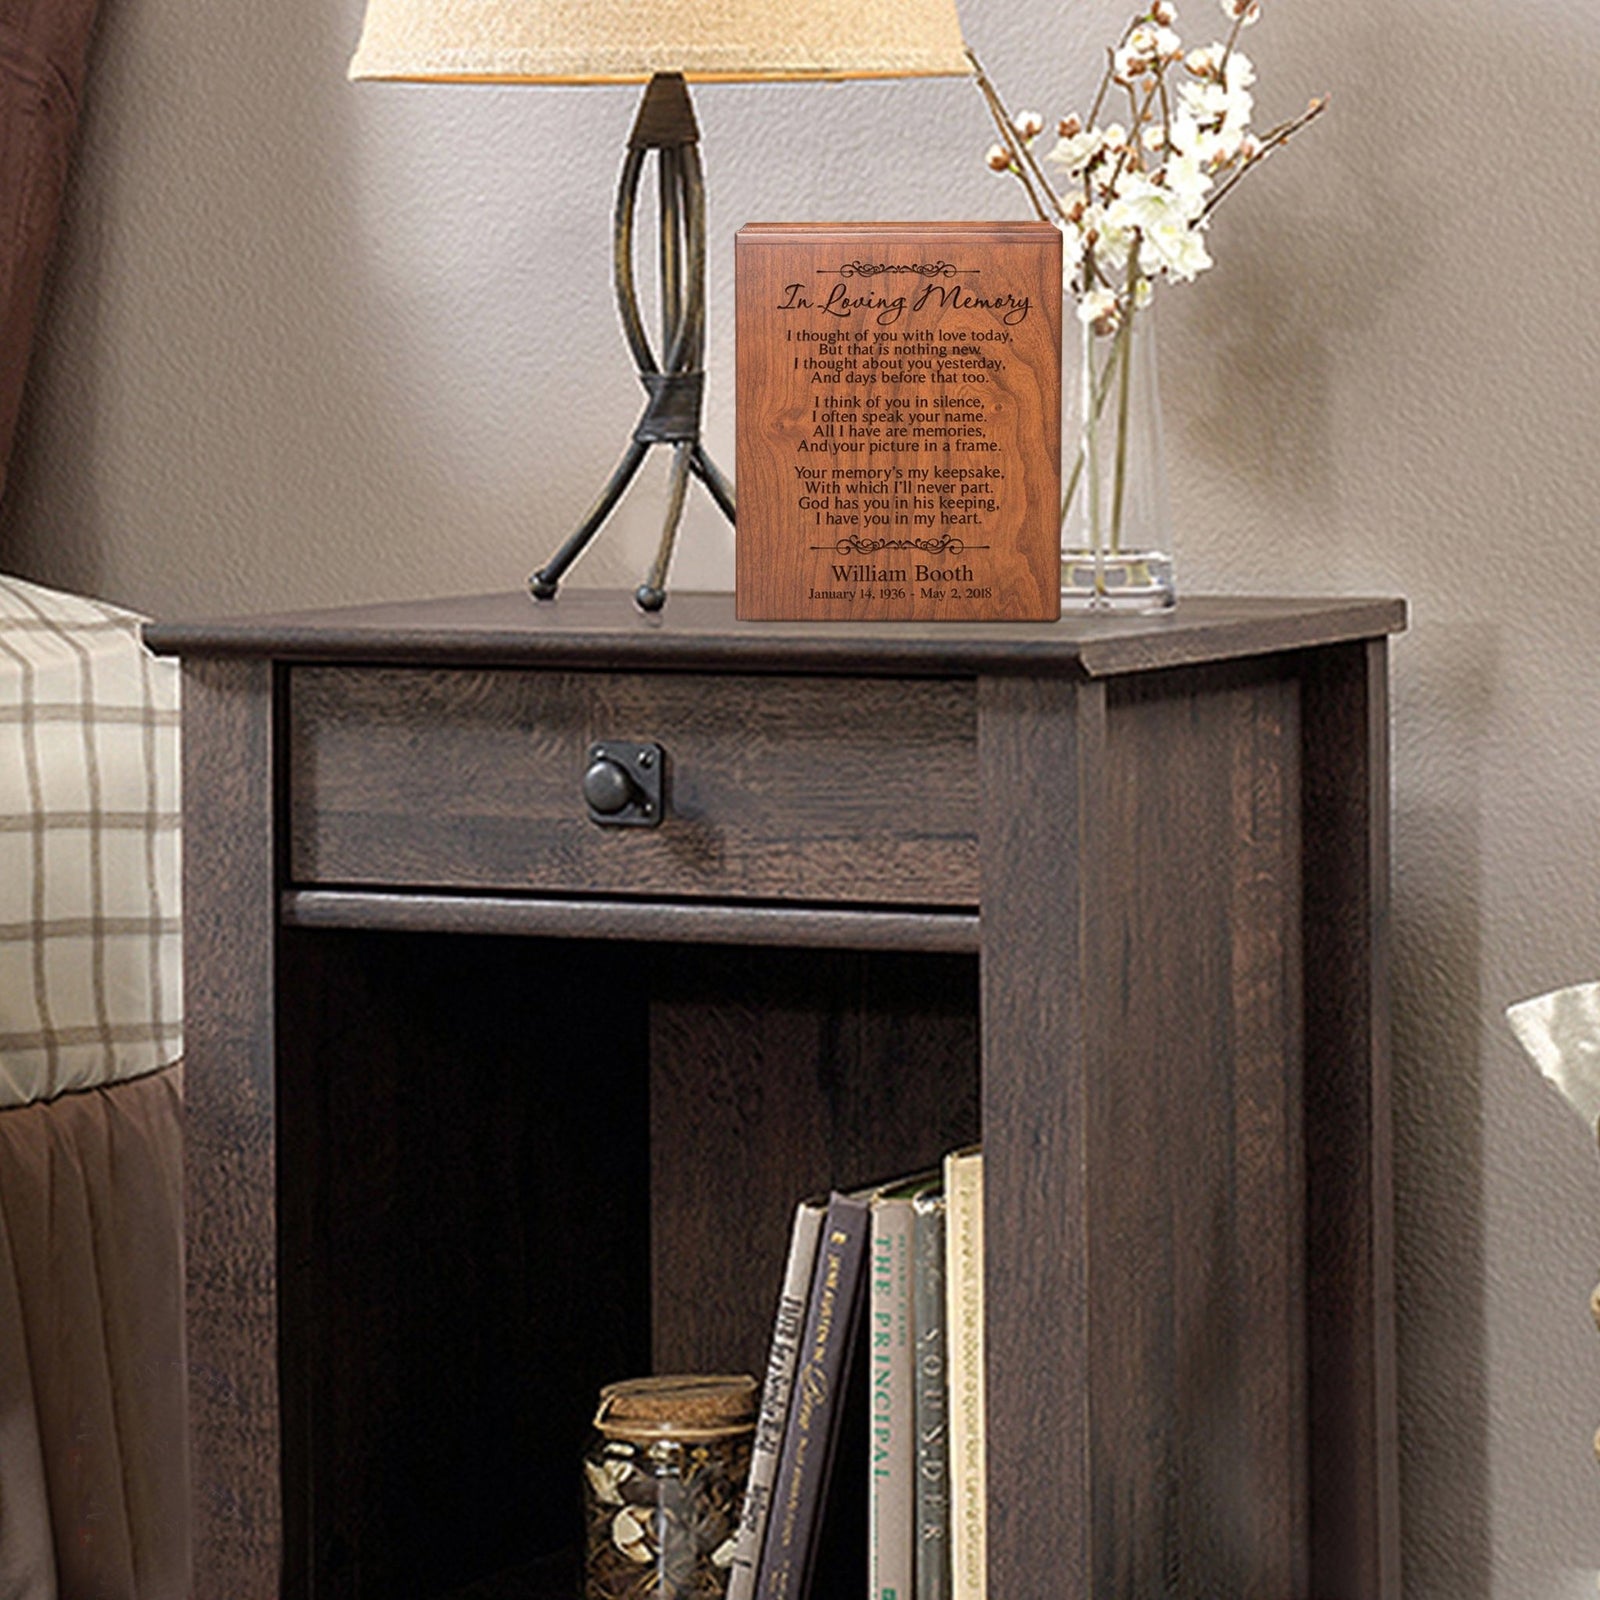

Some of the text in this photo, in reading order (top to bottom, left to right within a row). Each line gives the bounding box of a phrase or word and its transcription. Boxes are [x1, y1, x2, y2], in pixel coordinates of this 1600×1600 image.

[777, 284, 1032, 326] In Loving Memory
[787, 330, 1013, 344] I thought of you with love today,
[819, 344, 981, 358] But that is nothing new.
[794, 358, 1006, 372] I thought about you yesterday,
[811, 372, 989, 386] And days before that too.
[815, 396, 984, 410] I think of you in silence,
[812, 410, 987, 425] I often speak your name.
[813, 426, 986, 439] All I have are memories,
[798, 440, 1002, 455] And your picture in a frame.
[794, 466, 1004, 481] Your memory's my keepsake,
[805, 482, 994, 496] With which I'll never part.
[798, 497, 1000, 512] God has you in his keeping,
[816, 512, 982, 527] I have you in my heart.
[832, 565, 974, 582] William Booth
[808, 588, 856, 602] January
[860, 588, 876, 600] 14,
[880, 588, 906, 599] 1936
[920, 588, 946, 600] May
[950, 588, 960, 600] 2,
[966, 588, 992, 599] 2018
[873, 1234, 894, 1484] THE PRINCIPAL
[920, 1326, 943, 1540] SOUNDER
